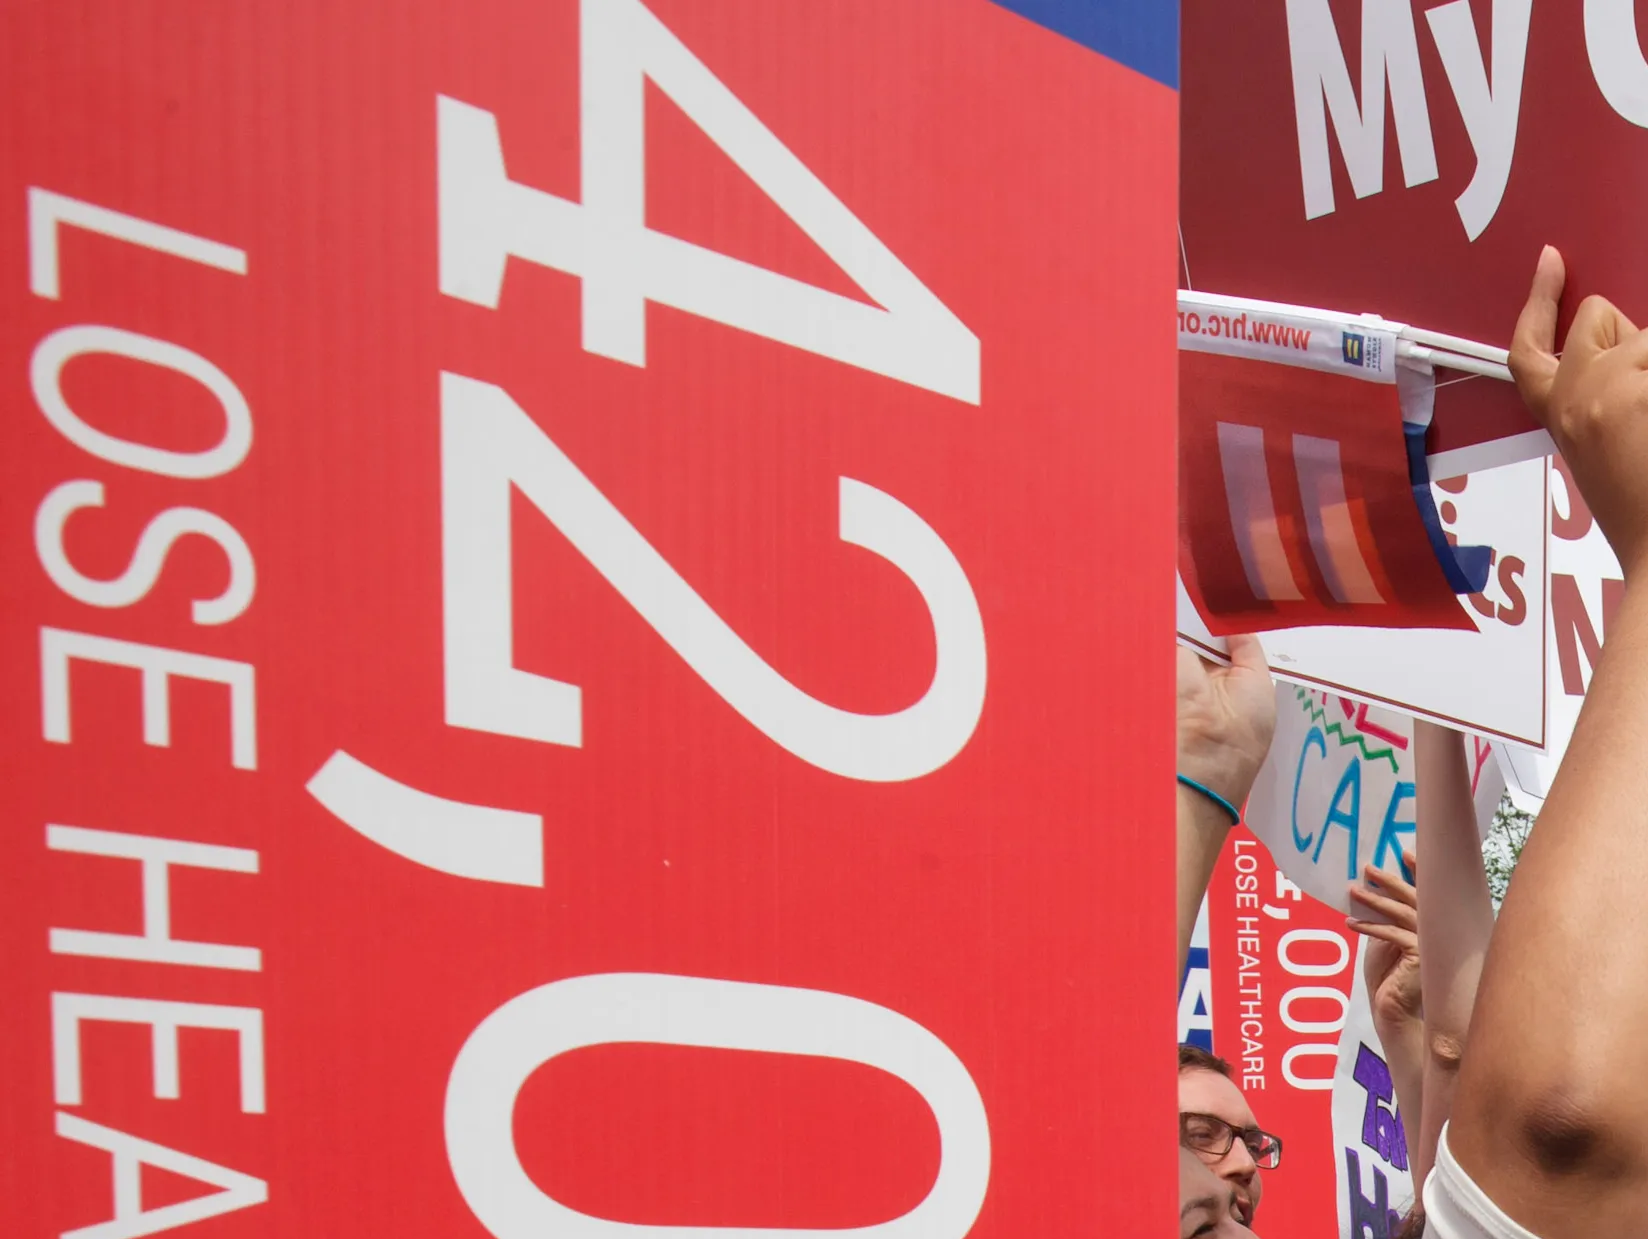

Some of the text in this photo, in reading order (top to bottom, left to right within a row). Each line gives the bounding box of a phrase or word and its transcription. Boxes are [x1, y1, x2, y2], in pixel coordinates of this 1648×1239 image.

[1287, 0, 1533, 243] My
[27, 185, 257, 772] LOSE
[1234, 840, 1266, 1090] LOSE HEALTHCARE
[1261, 870, 1350, 1090] ,000
